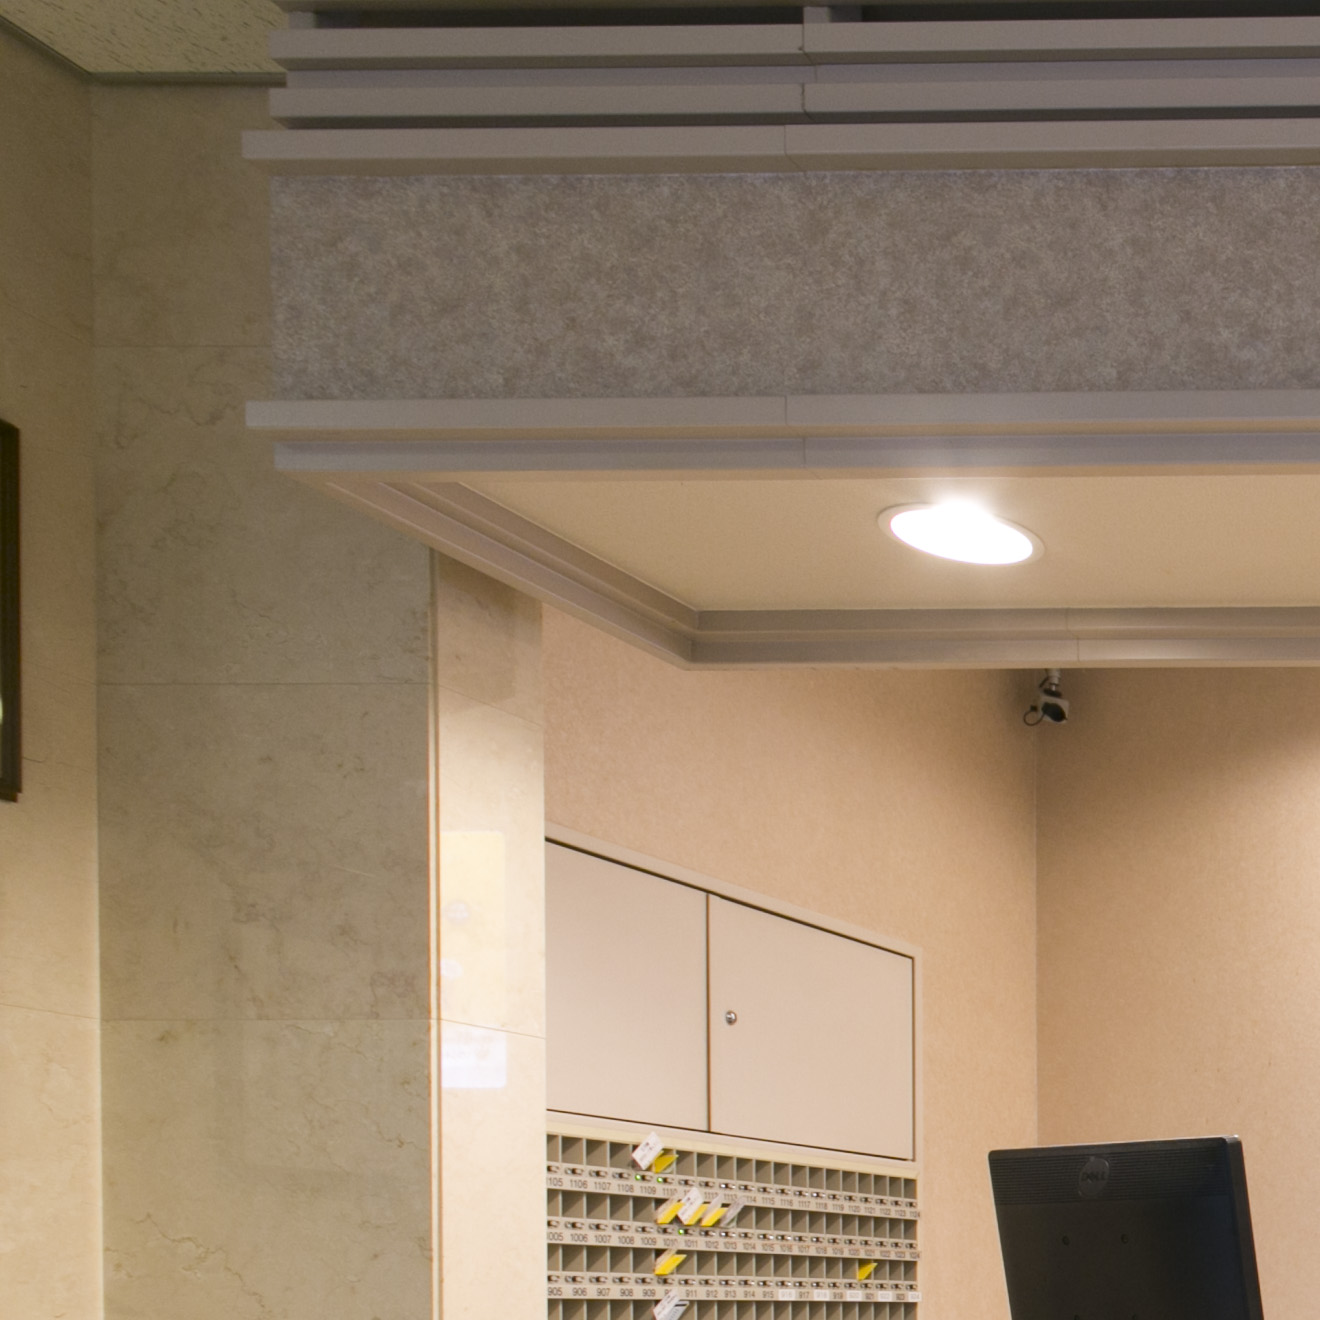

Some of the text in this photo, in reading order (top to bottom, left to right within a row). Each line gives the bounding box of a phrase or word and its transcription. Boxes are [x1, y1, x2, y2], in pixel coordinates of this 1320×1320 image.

[570, 1178, 588, 1188] 1106
[594, 1181, 612, 1190] 1107
[617, 1183, 634, 1192] 1108
[640, 1185, 656, 1194] 1109
[723, 1193, 738, 1202] 1113
[761, 1196, 776, 1205] 1115
[570, 1232, 588, 1242] 1006
[594, 1234, 612, 1243] 1007
[618, 1235, 635, 1244] 1008
[640, 1236, 657, 1245] 1009
[683, 1238, 699, 1247] 1011
[704, 1239, 719, 1248] 1012
[547, 1286, 564, 1296] 905
[572, 1287, 588, 1296] 906
[596, 1287, 611, 1296] 907
[619, 1288, 634, 1297] 908
[641, 1288, 656, 1297] 909
[684, 1289, 698, 1297] 911
[705, 1289, 718, 1298] 912
[725, 1289, 738, 1298] 913
[744, 1290, 757, 1298] 914
